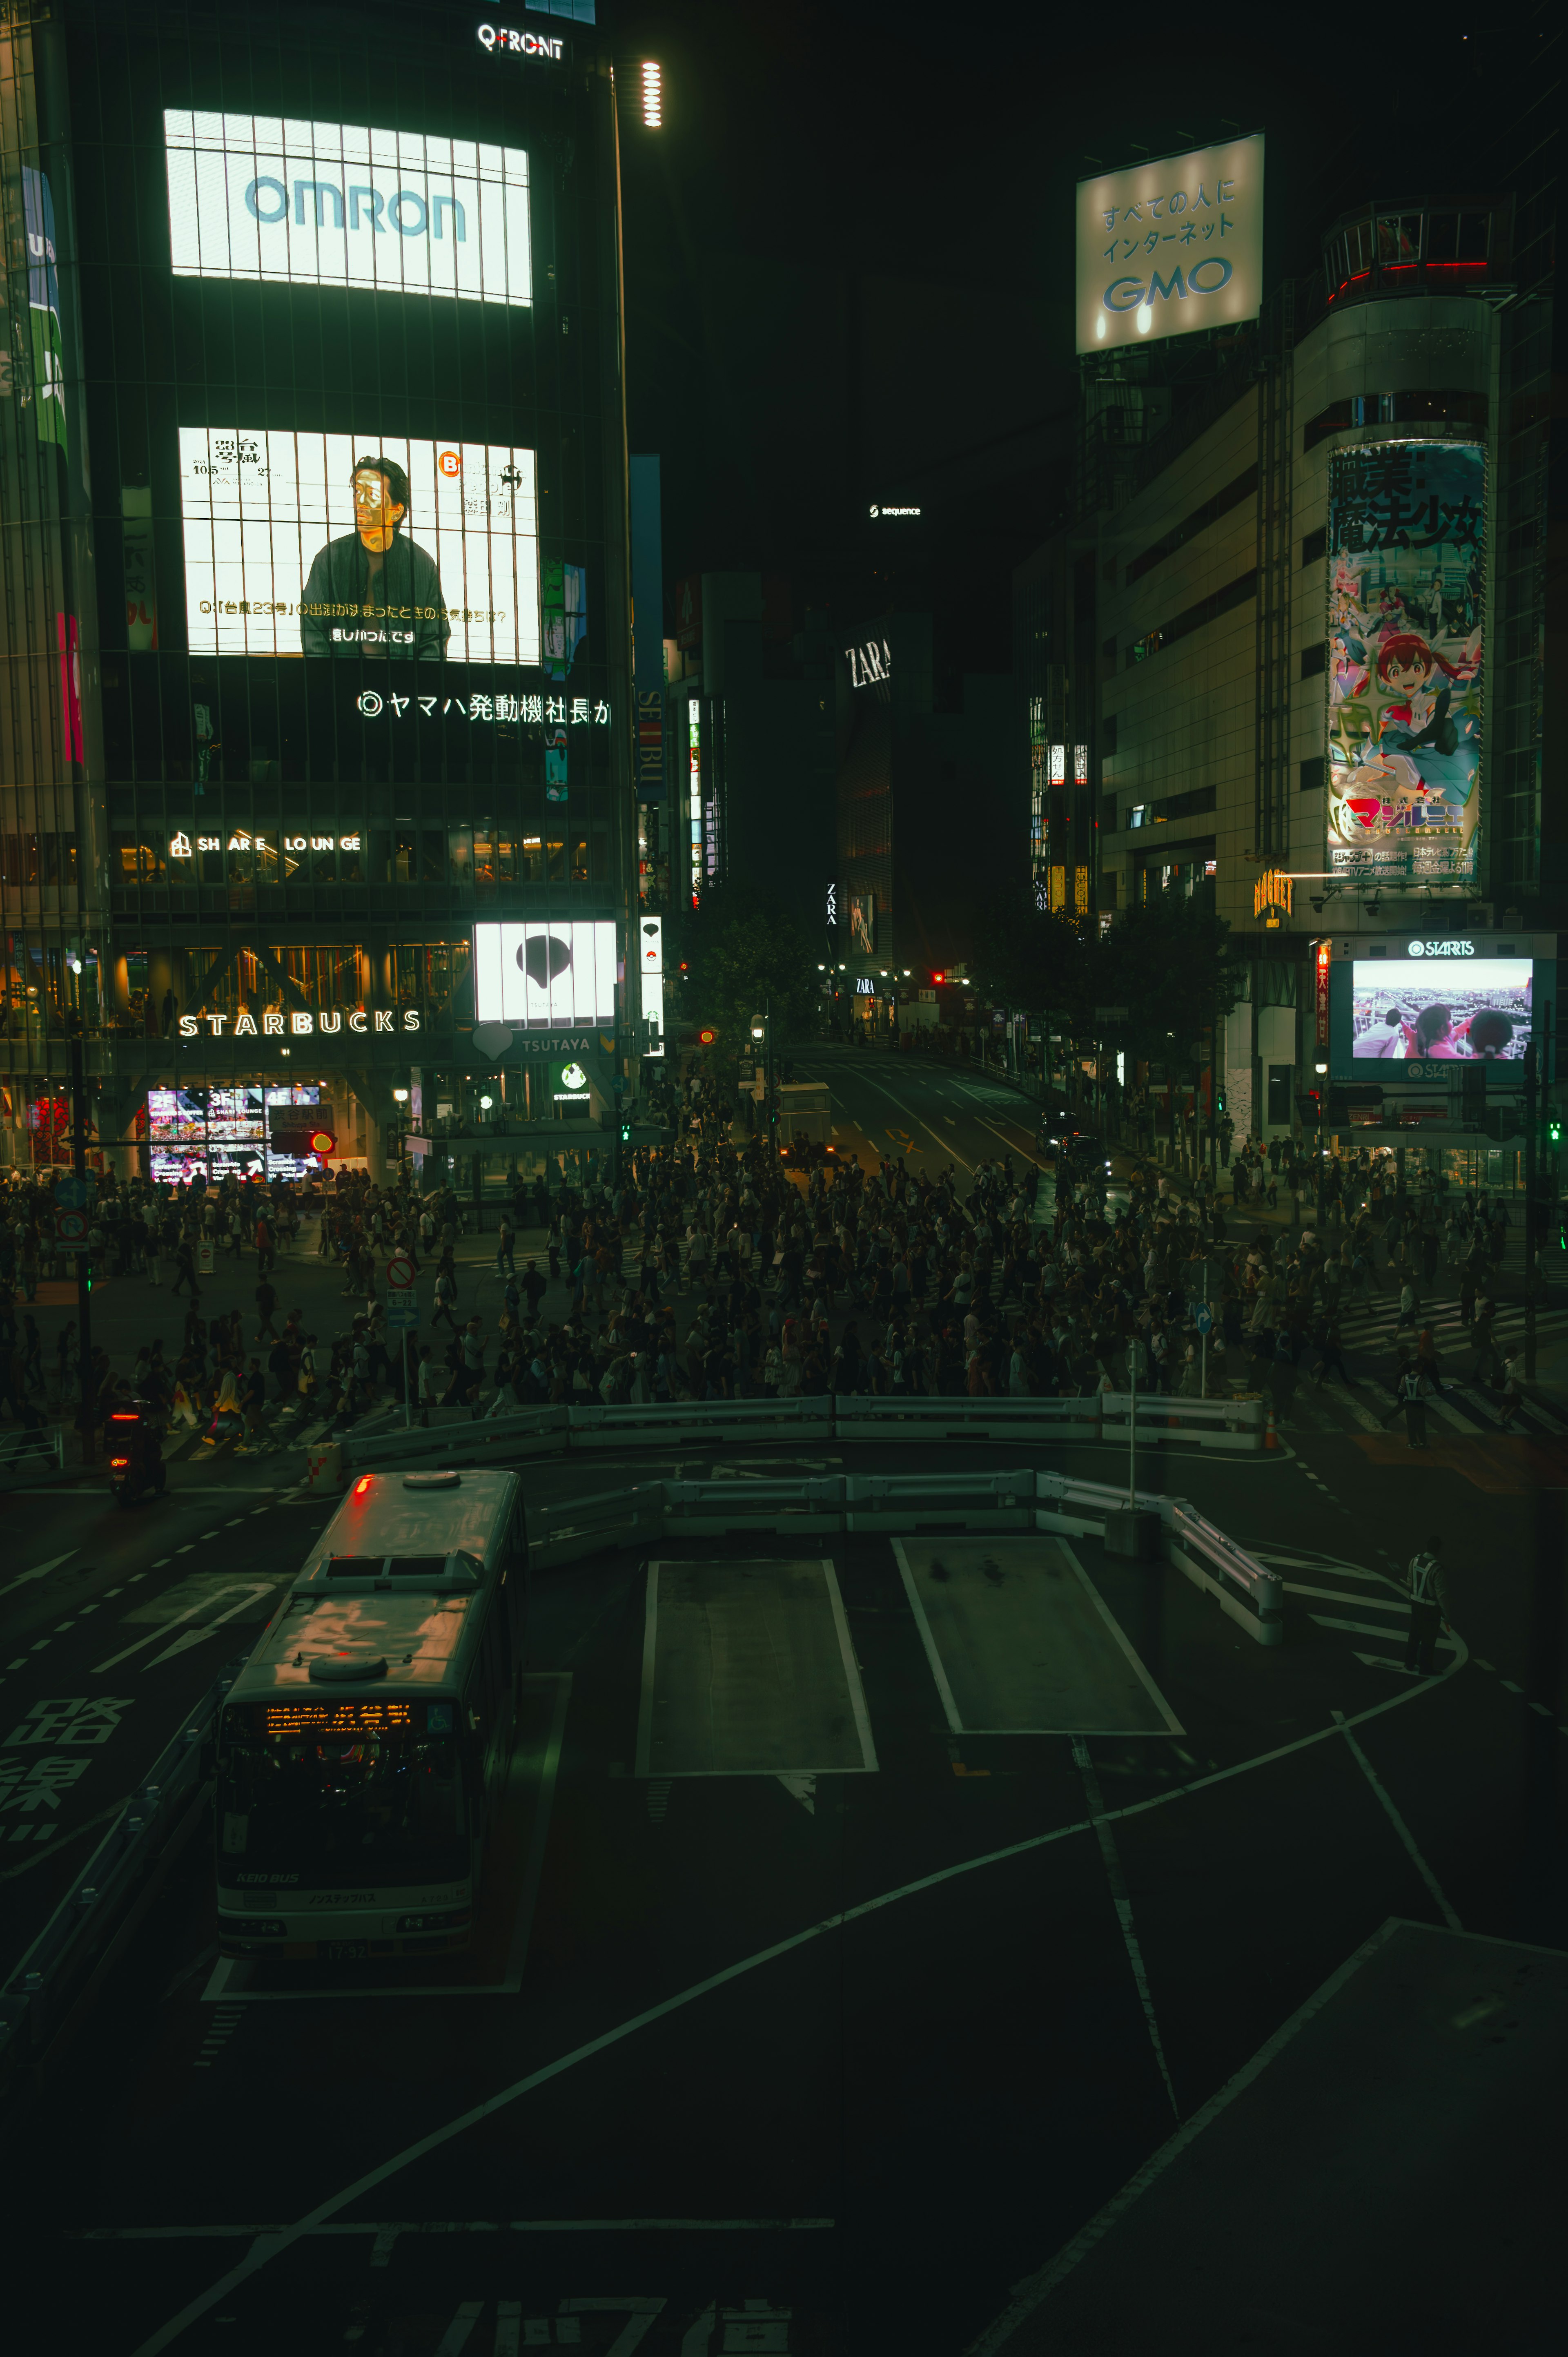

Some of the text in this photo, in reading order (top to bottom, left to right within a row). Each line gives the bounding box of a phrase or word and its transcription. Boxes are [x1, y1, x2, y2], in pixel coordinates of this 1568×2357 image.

[1102, 180, 1235, 233] すべての人に
[1102, 212, 1234, 264] インターネット
[1102, 257, 1234, 313] GMO
[882, 508, 921, 516] sequence
[638, 690, 664, 783] SEIBU
[1052, 747, 1064, 778] 処方せん
[198, 837, 361, 852] SHARE LOUNGE
[1254, 868, 1293, 919] MAGNET
[826, 883, 837, 925] ZARA
[856, 978, 875, 994] ZARA
[179, 1010, 421, 1037] STARBUCKS
[522, 1038, 590, 1052] TSUTAYA
[151, 1095, 174, 1108] 2F
[210, 1093, 231, 1106] 3F
[267, 1091, 287, 1104] 4F
[274, 1108, 328, 1120] 渋谷駅前
[236, 1873, 300, 1883] KEIO BUS
[309, 1893, 376, 1904] ノンステップバス
